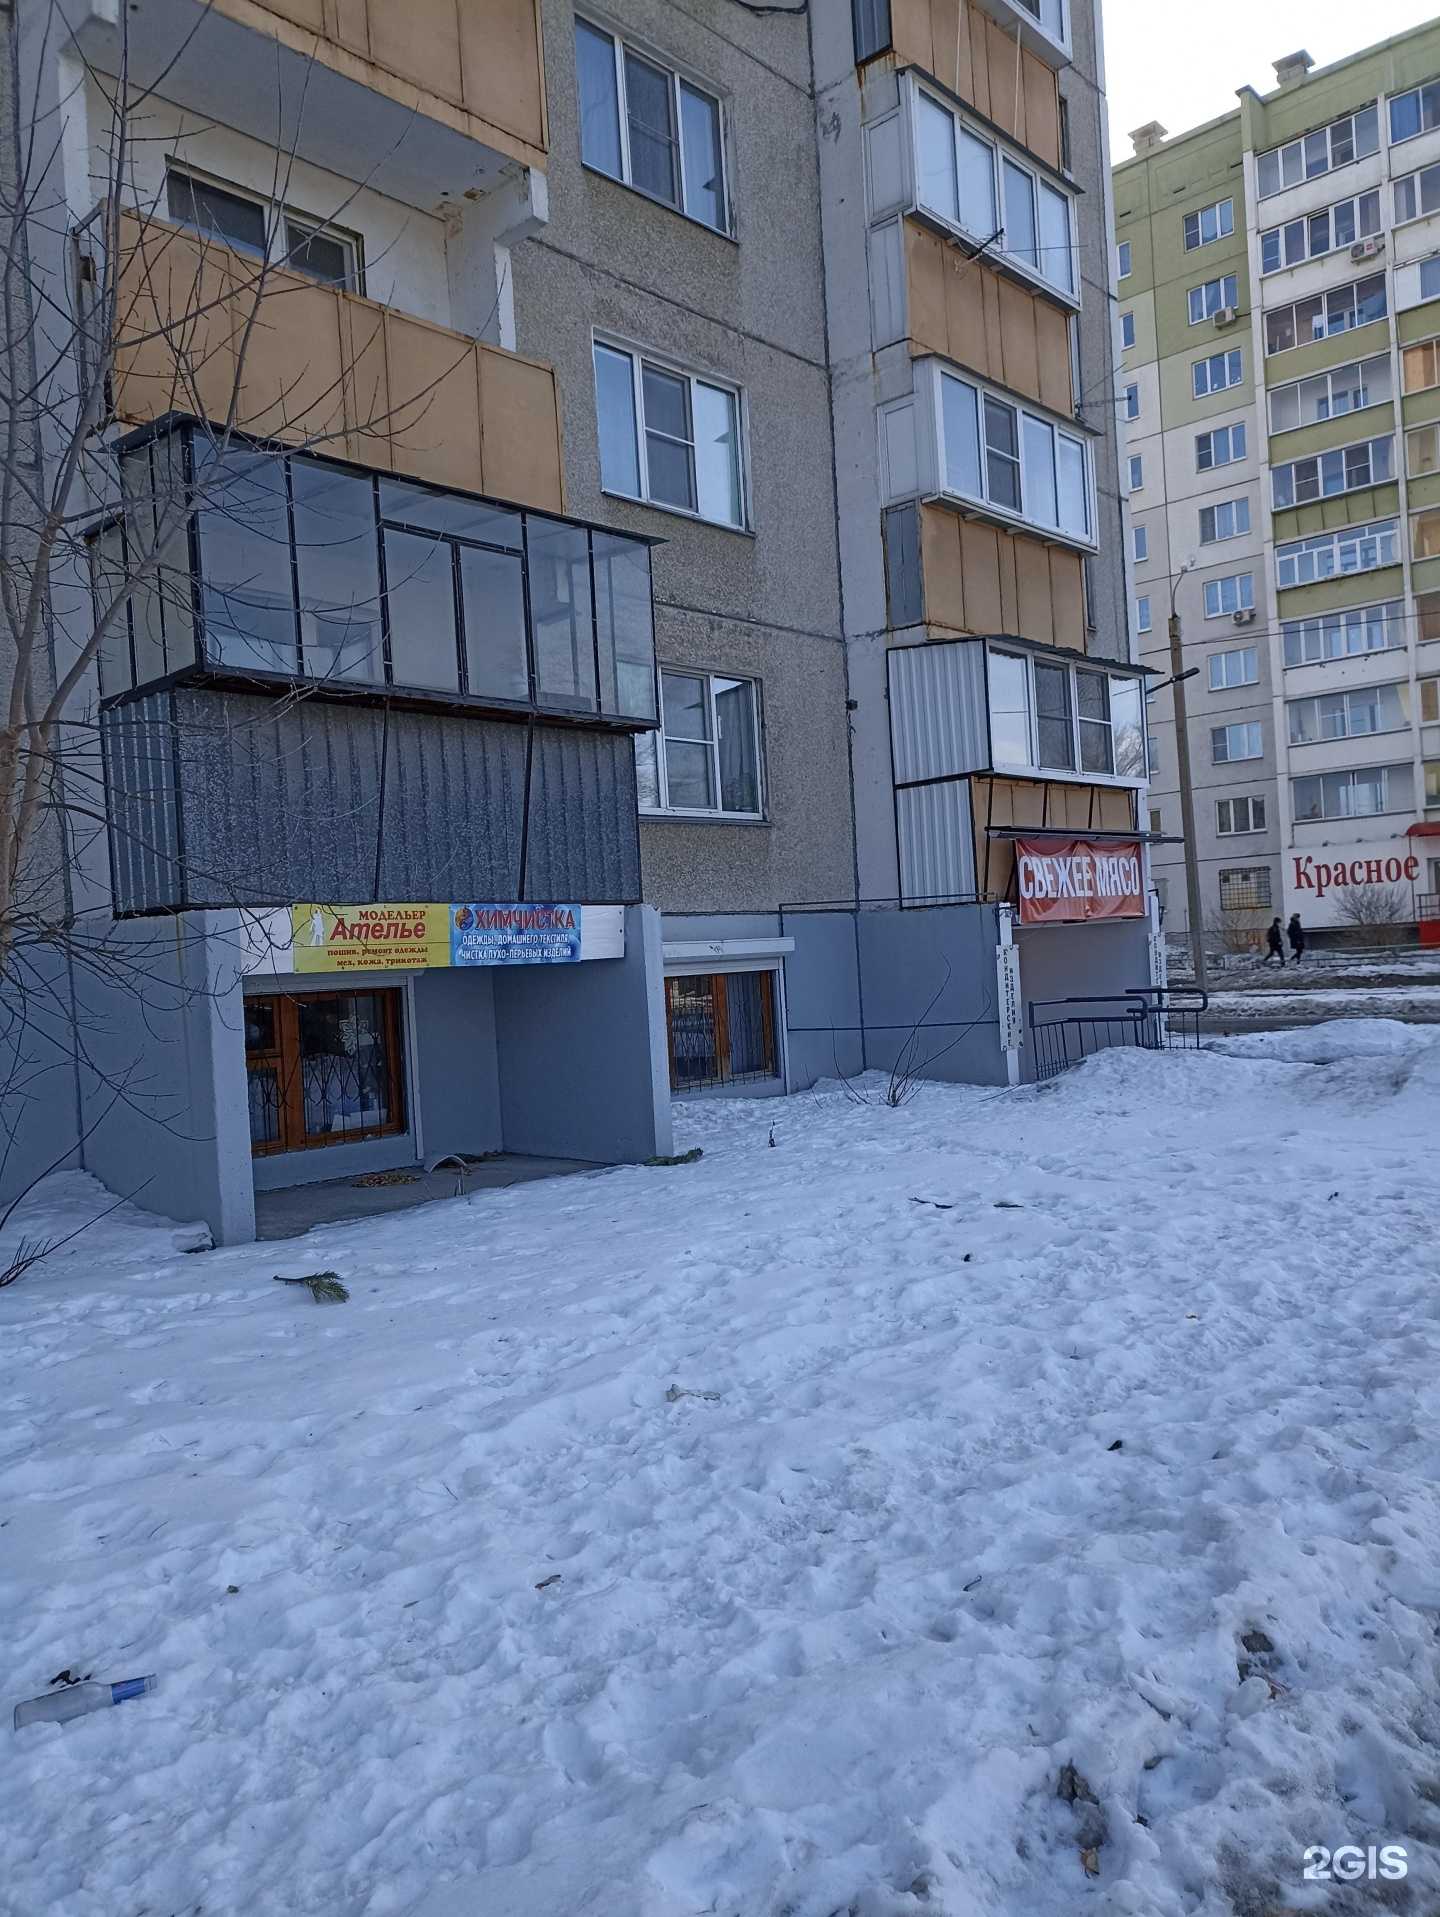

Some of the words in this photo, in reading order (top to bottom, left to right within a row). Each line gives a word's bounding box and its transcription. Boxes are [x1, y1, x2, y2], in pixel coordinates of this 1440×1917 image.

[1019, 856, 1093, 899] СВЕЖЕЕ
[1094, 856, 1140, 897] МЯСО
[1292, 855, 1420, 898] Красное
[359, 910, 426, 921] МОДЕЛЬЕР
[475, 909, 576, 930] ХИМЧИСТКА
[330, 917, 426, 940] Ателье
[498, 934, 538, 945] ДОМАШНЕГО
